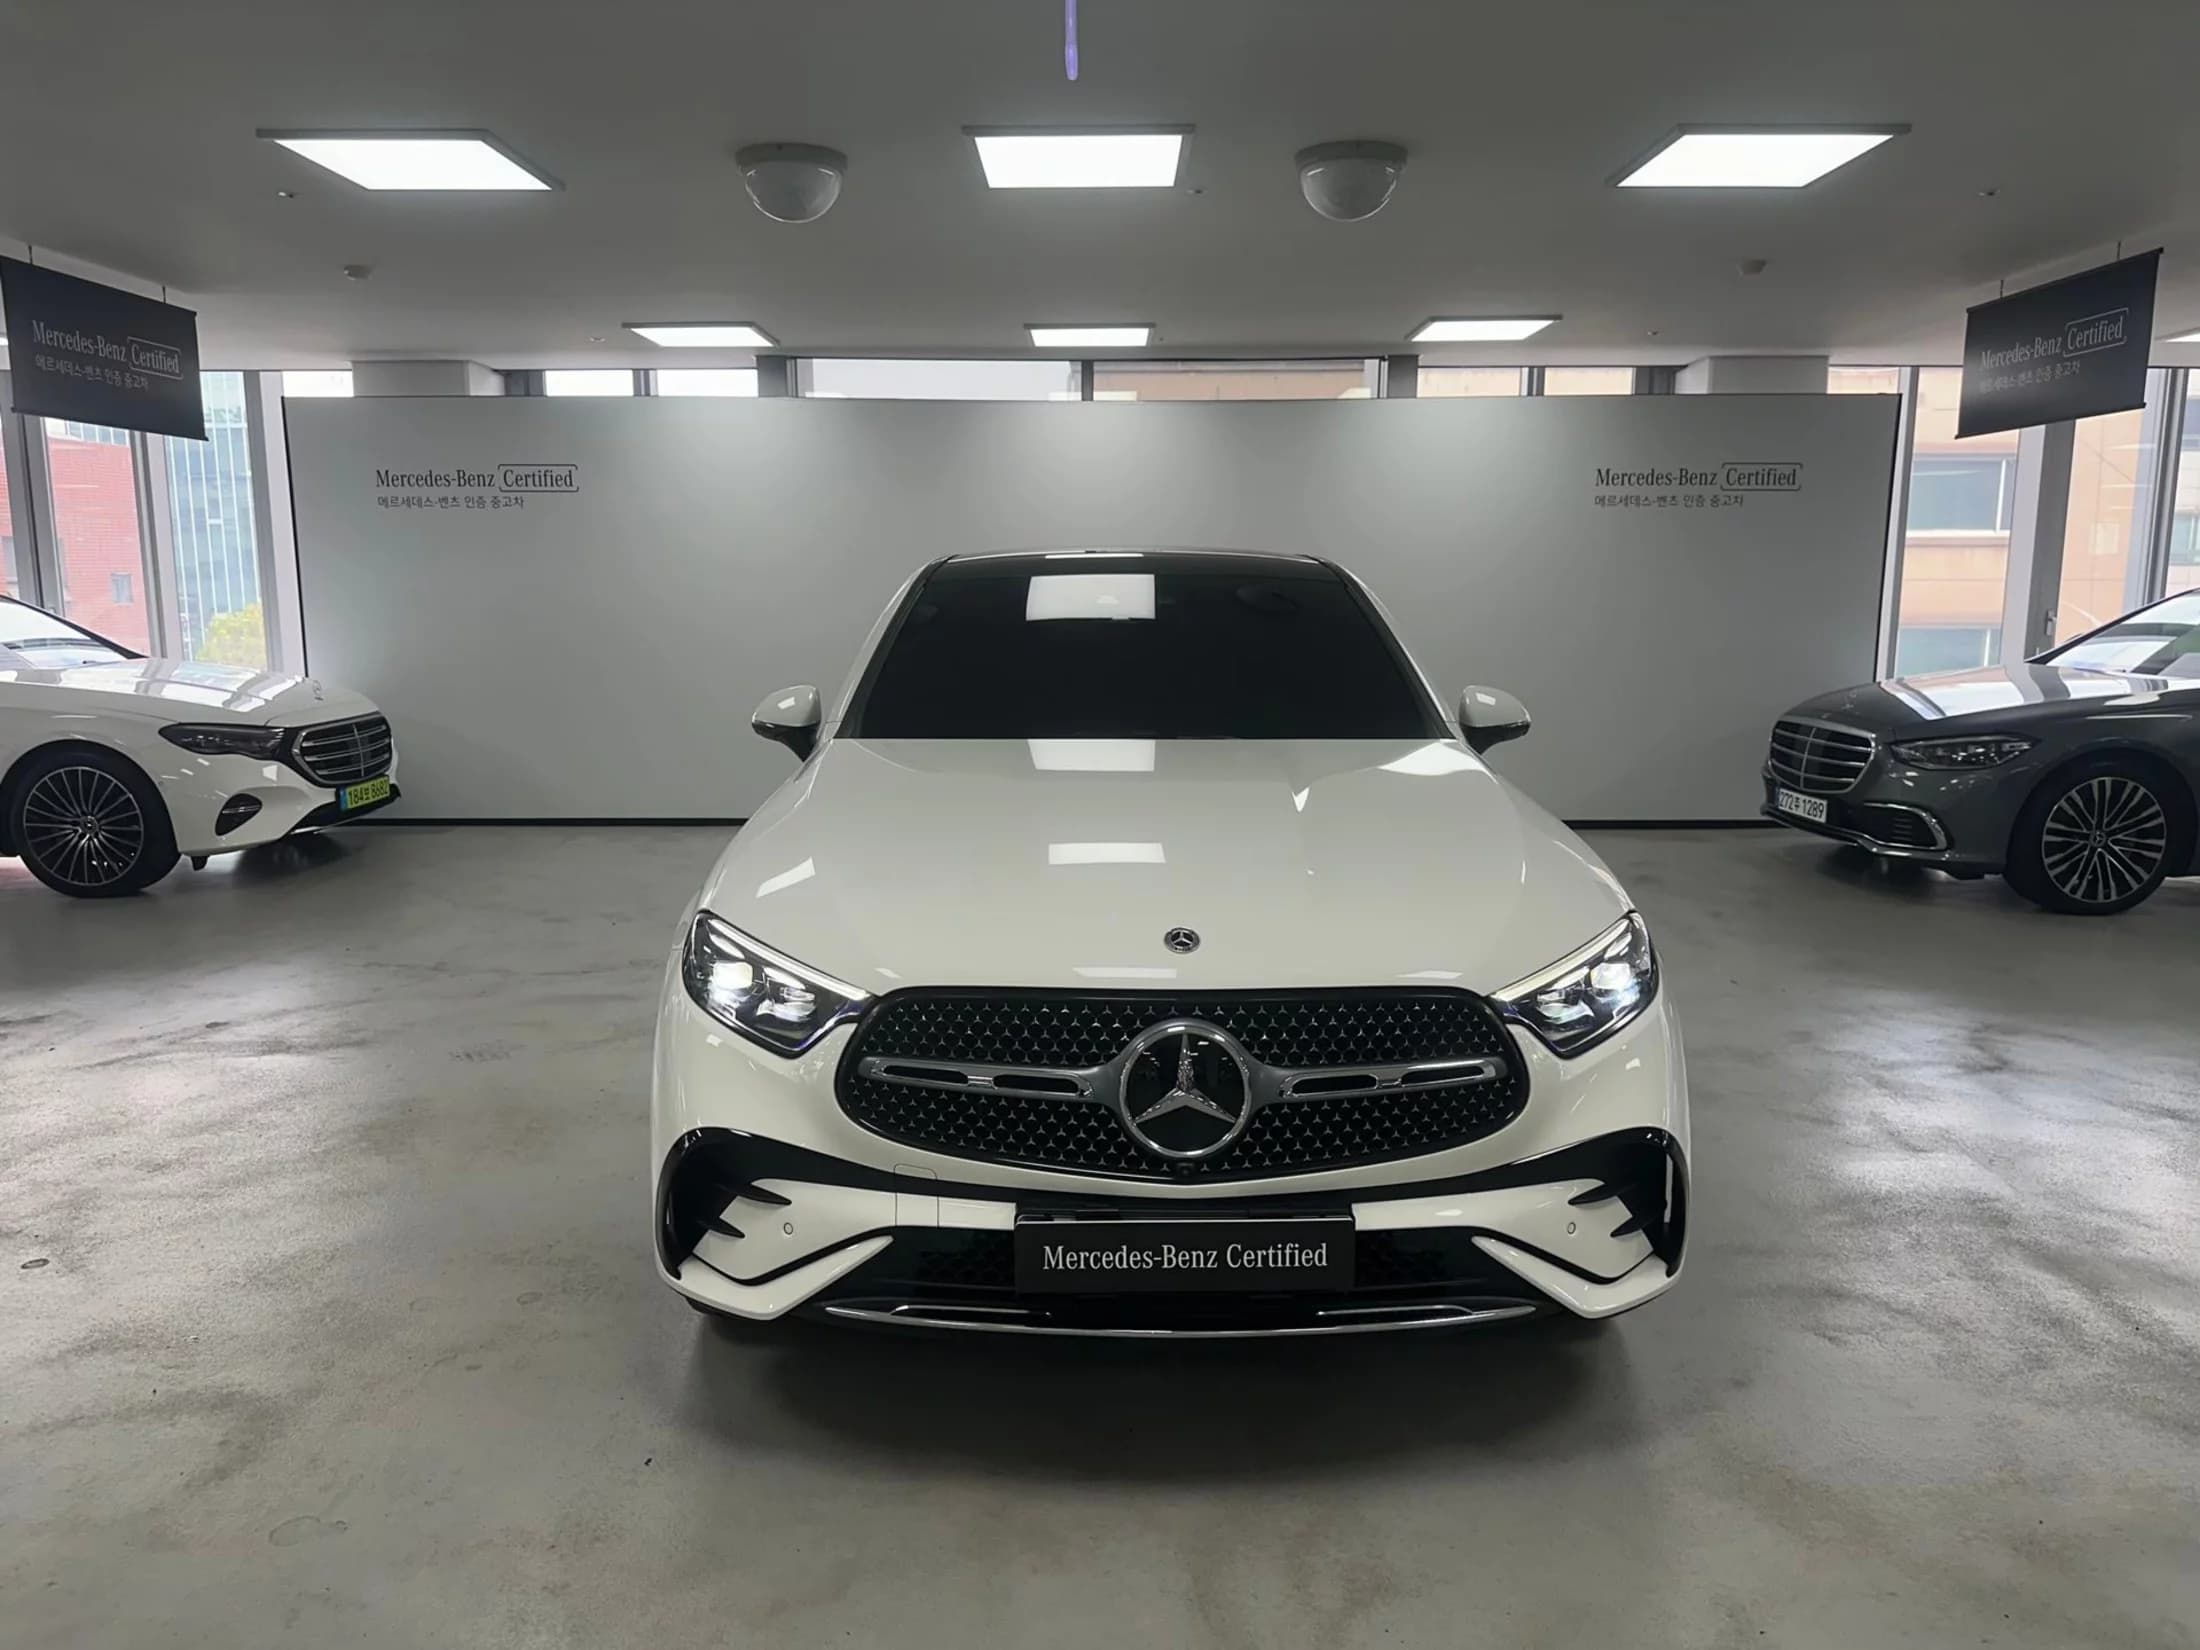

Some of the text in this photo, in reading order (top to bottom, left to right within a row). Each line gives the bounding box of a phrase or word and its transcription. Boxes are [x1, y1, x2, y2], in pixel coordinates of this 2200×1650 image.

[32, 319, 180, 374] Mercedes-Benz Certified
[1980, 316, 2123, 371] Mercedes-Benz Certified
[375, 469, 573, 488] Mercedes-Benz Certified
[1595, 467, 1797, 487] Mercedes-Benz Certified
[464, 495, 486, 509] 인증
[490, 495, 525, 509] 중고차
[1683, 494, 1705, 508] 인증
[1710, 494, 1744, 508] 중고차
[1043, 1243, 1328, 1270] Mercedes-Benz Certified
